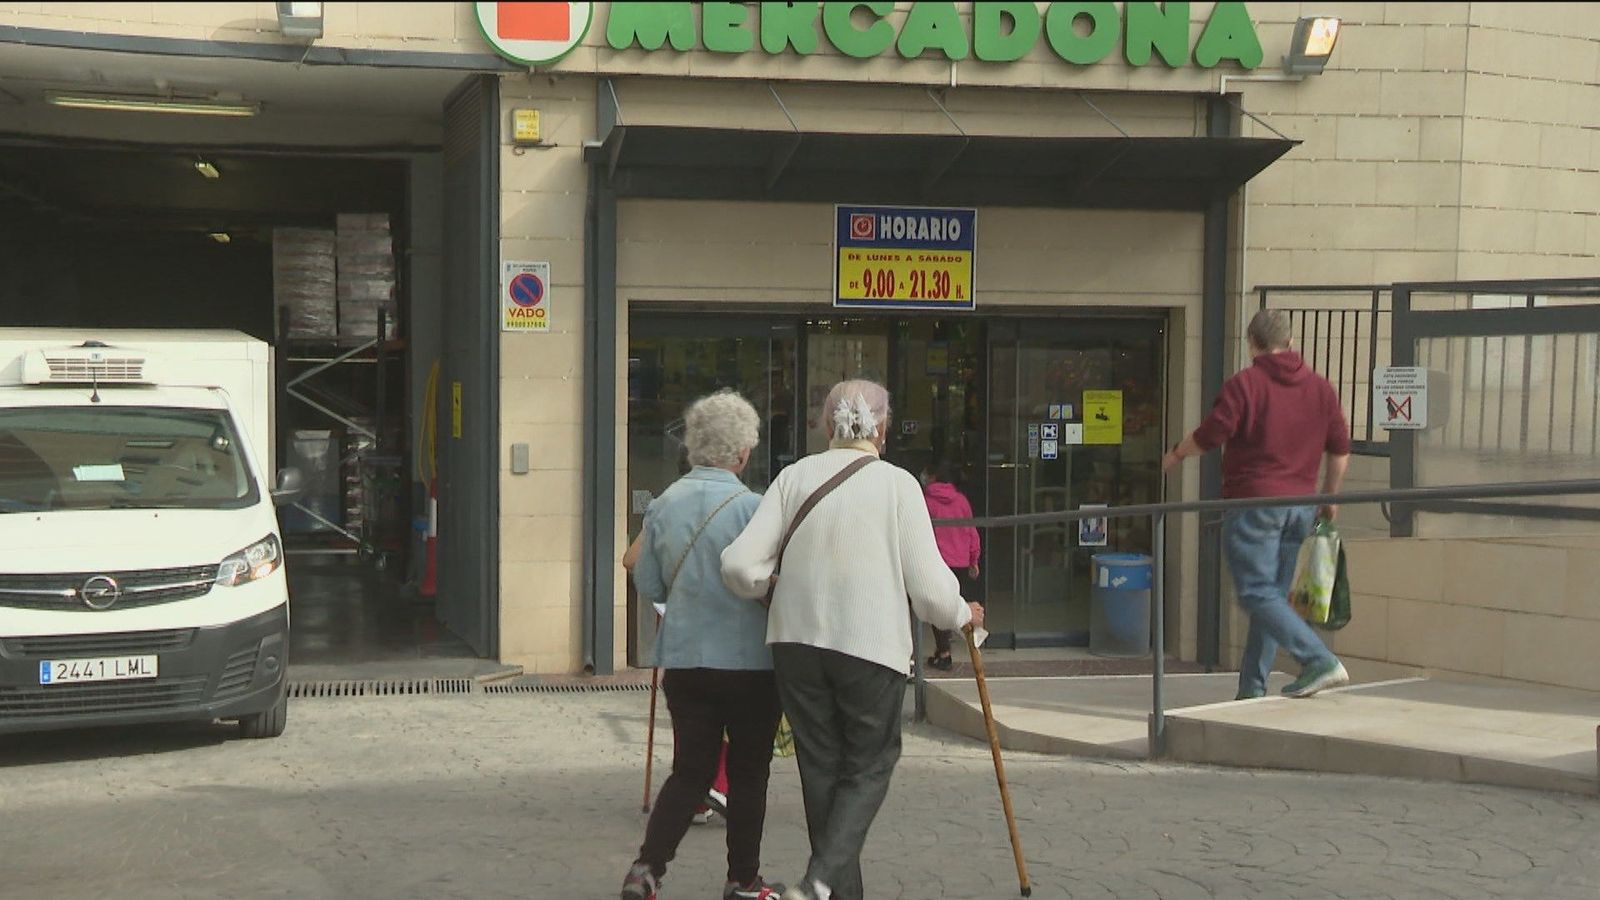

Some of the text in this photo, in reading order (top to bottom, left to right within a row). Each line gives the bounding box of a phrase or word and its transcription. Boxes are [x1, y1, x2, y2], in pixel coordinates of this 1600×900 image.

[606, 2, 1264, 68] MERCADONA
[880, 215, 961, 241] HORARIO
[848, 253, 861, 261] DE
[866, 254, 900, 262] LUNES
[906, 254, 913, 262] A
[849, 281, 859, 290] DE
[863, 268, 896, 298] 9.00
[899, 282, 905, 290] A
[910, 270, 951, 299] 21.30
[508, 307, 546, 318] VADO
[56, 661, 106, 680] 2441
[114, 658, 152, 676] LML
